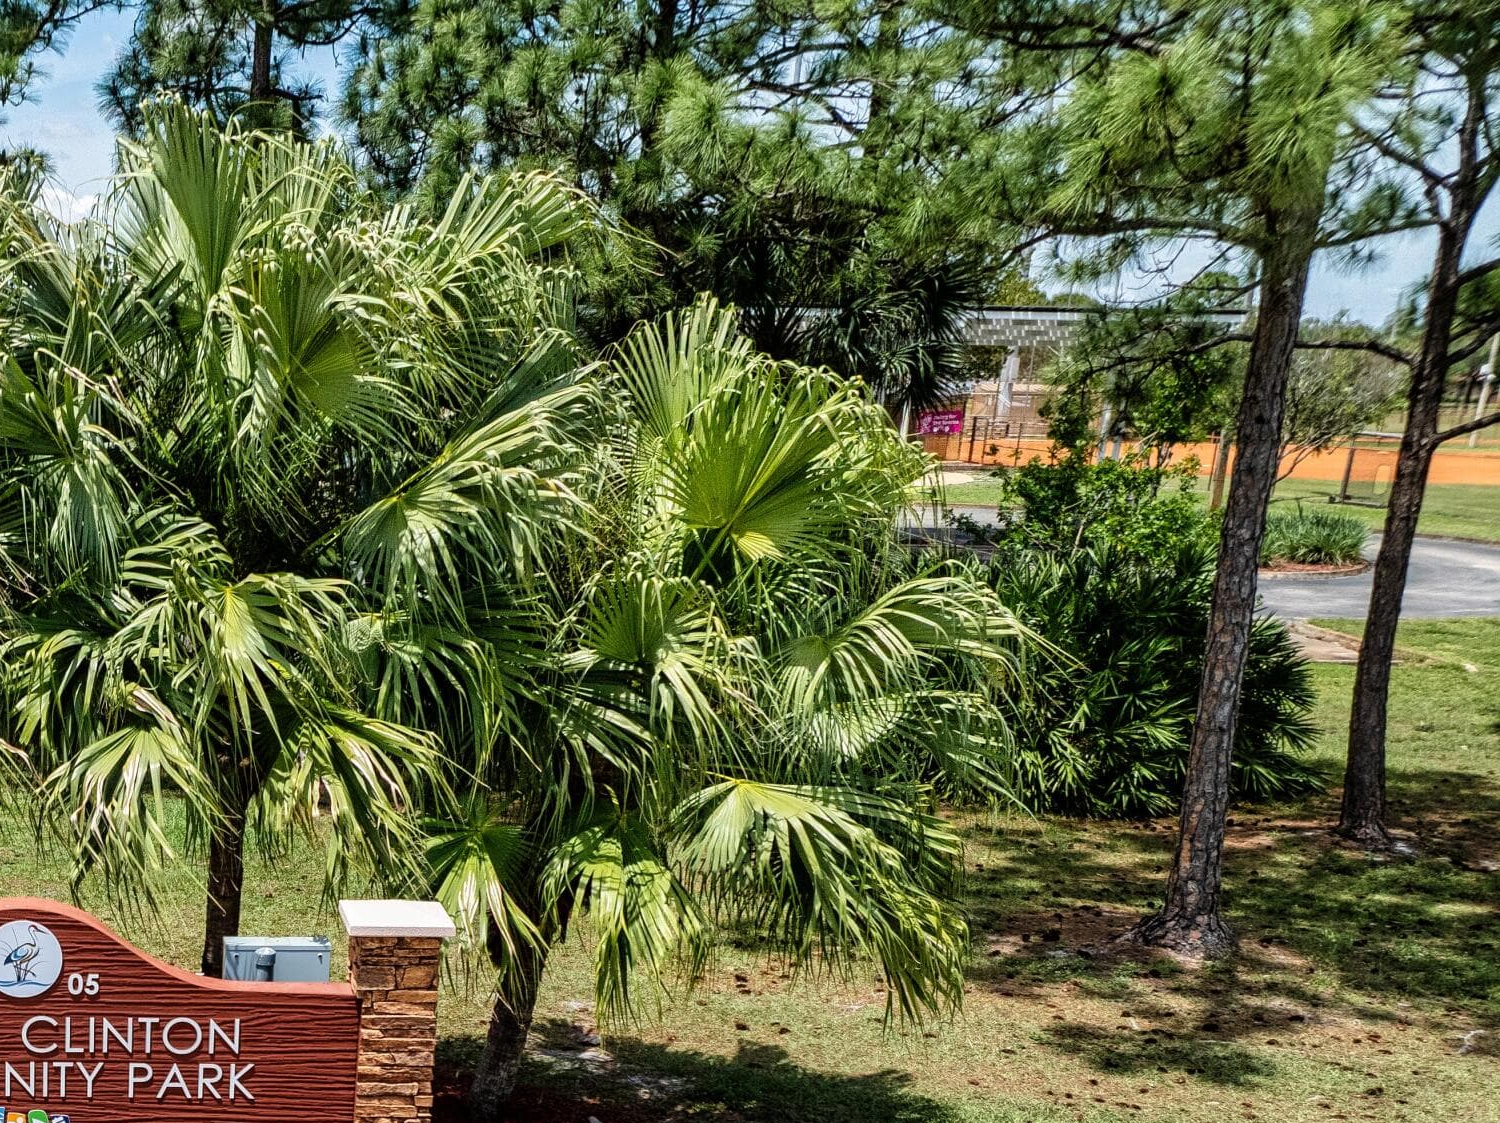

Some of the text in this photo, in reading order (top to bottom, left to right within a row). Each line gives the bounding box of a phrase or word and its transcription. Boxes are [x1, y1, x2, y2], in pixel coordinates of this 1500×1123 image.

[67, 973, 100, 996] 05
[21, 1015, 241, 1055] CLINTON
[128, 1062, 255, 1100] PARK
